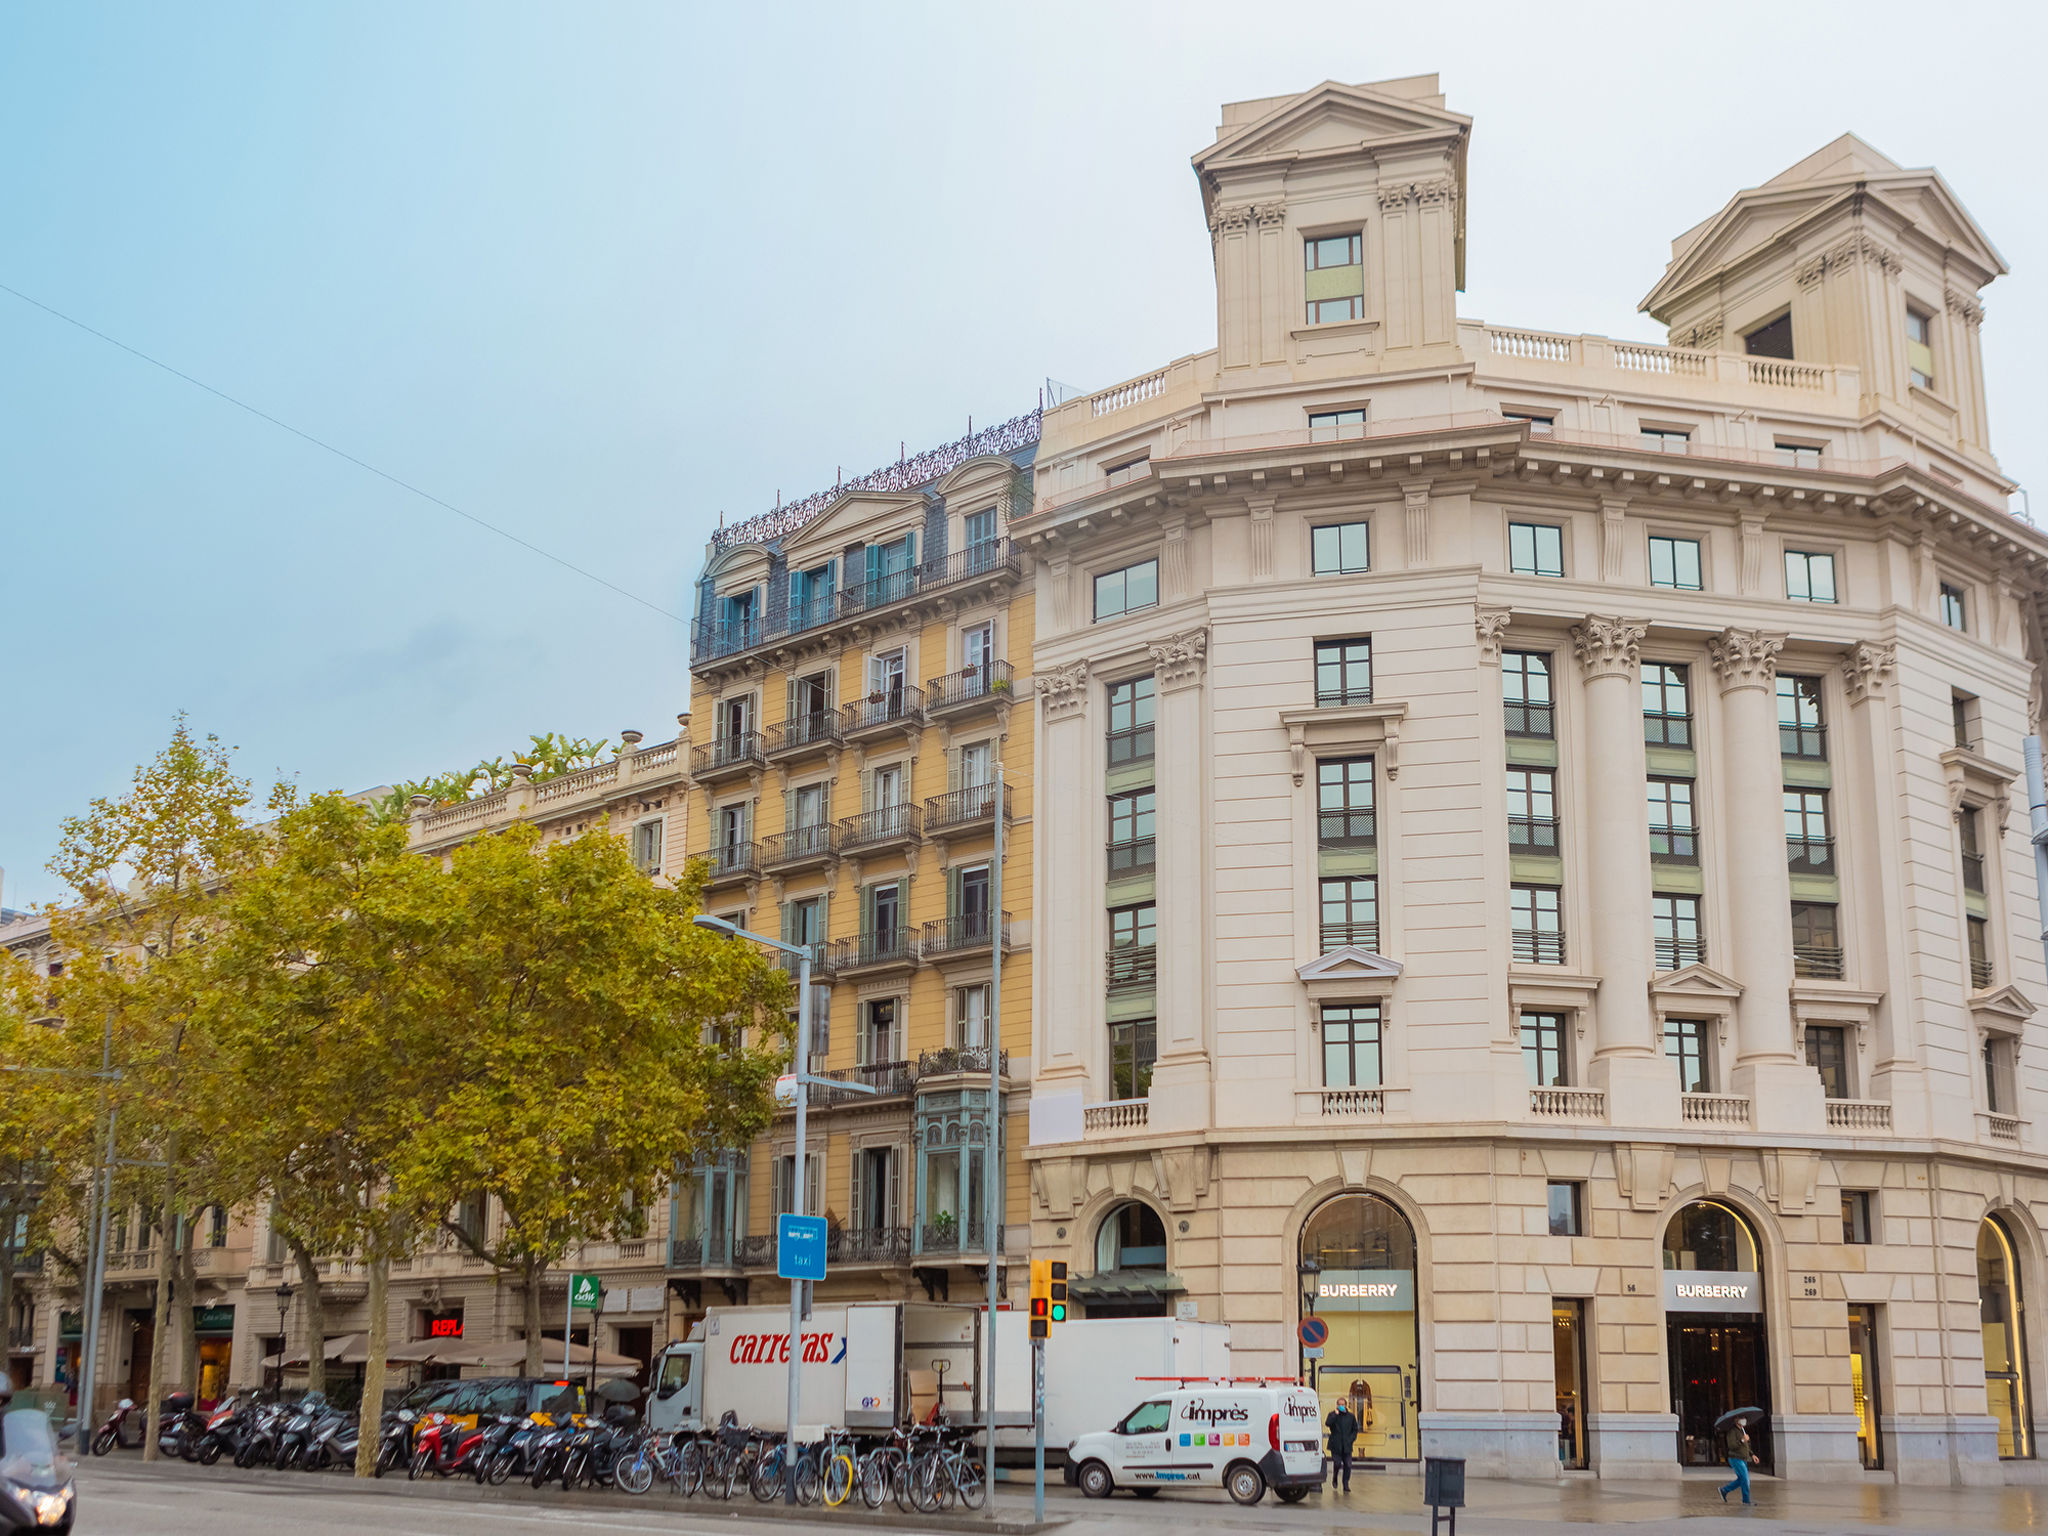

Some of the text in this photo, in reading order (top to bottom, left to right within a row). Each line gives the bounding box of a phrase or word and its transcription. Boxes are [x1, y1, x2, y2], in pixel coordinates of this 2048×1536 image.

[794, 1254, 811, 1266] taxi
[1320, 1284, 1397, 1297] BURBERRY
[1676, 1284, 1747, 1298] BURBERRY
[729, 1332, 834, 1364] carreras
[1181, 1397, 1249, 1428] imprès
[1284, 1395, 1318, 1424] imprès
